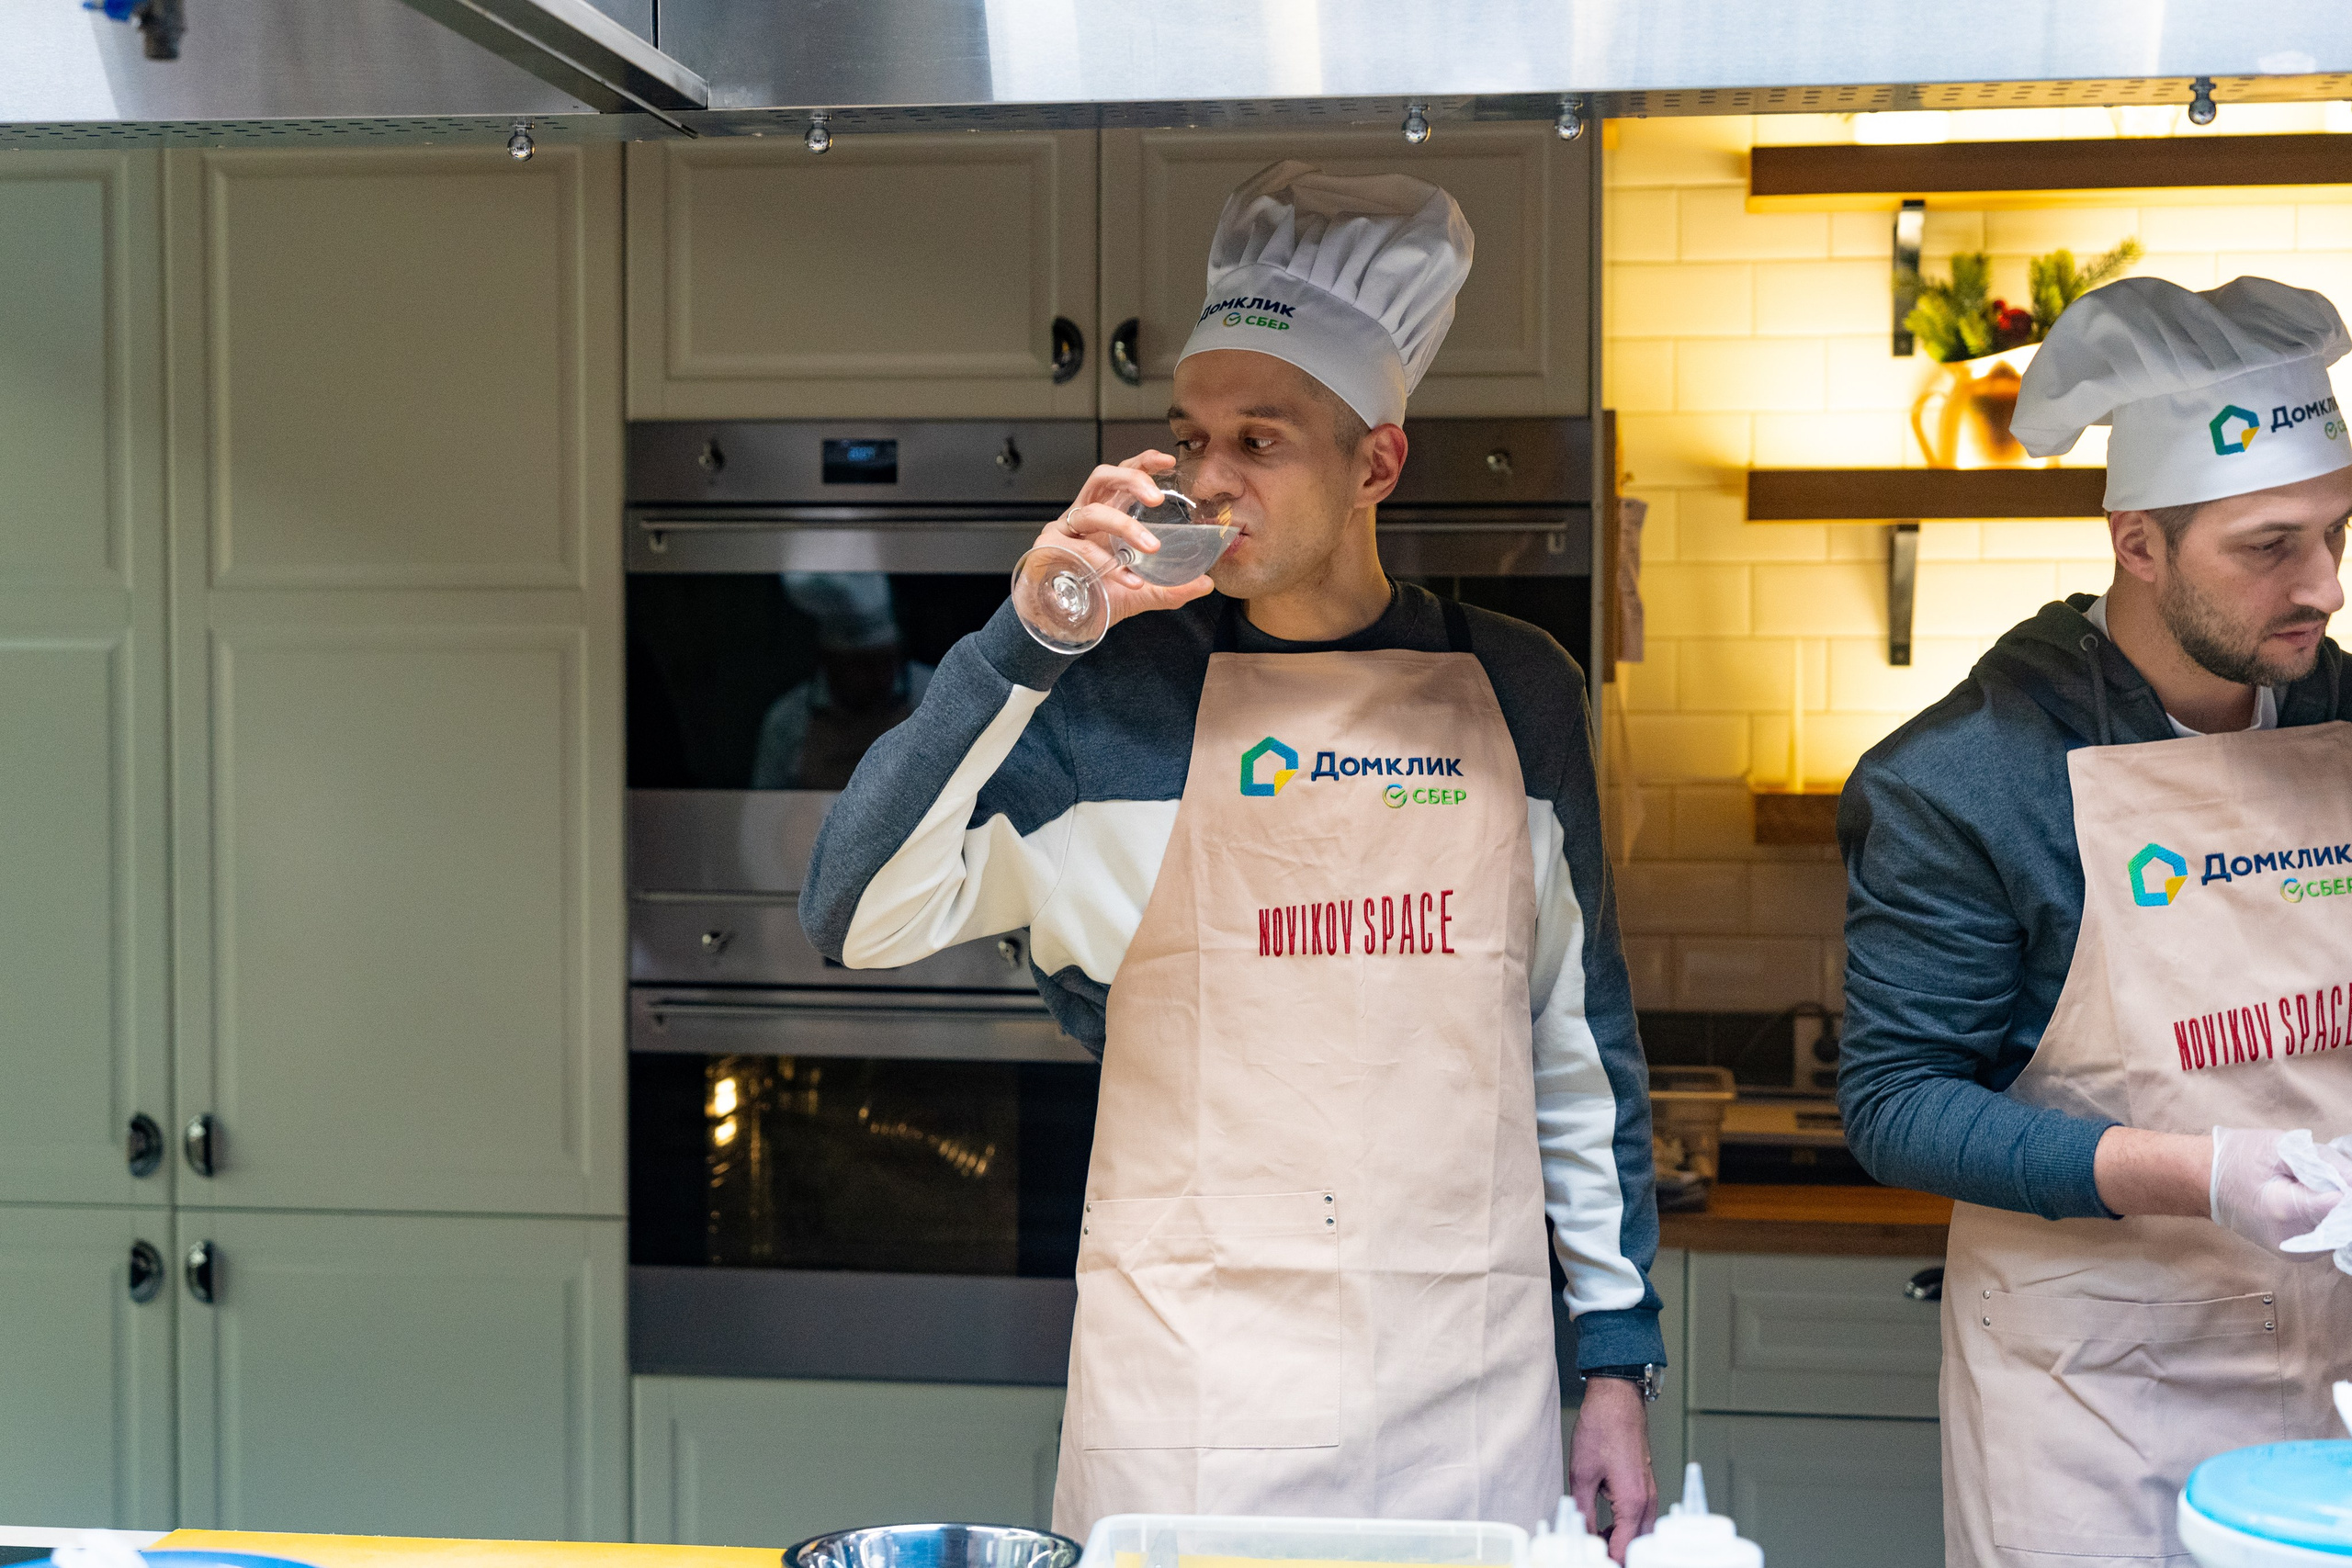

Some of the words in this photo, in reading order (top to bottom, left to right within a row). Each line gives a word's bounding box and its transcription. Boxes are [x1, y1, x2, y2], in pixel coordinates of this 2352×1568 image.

[1245, 315, 1290, 331] СБЕР
[1412, 788, 1467, 805] СБЕР
[1259, 899, 1352, 956] NOVIKOV
[1363, 889, 1454, 954] SPACE
[2174, 1002, 2274, 1070] NOVIKOV
